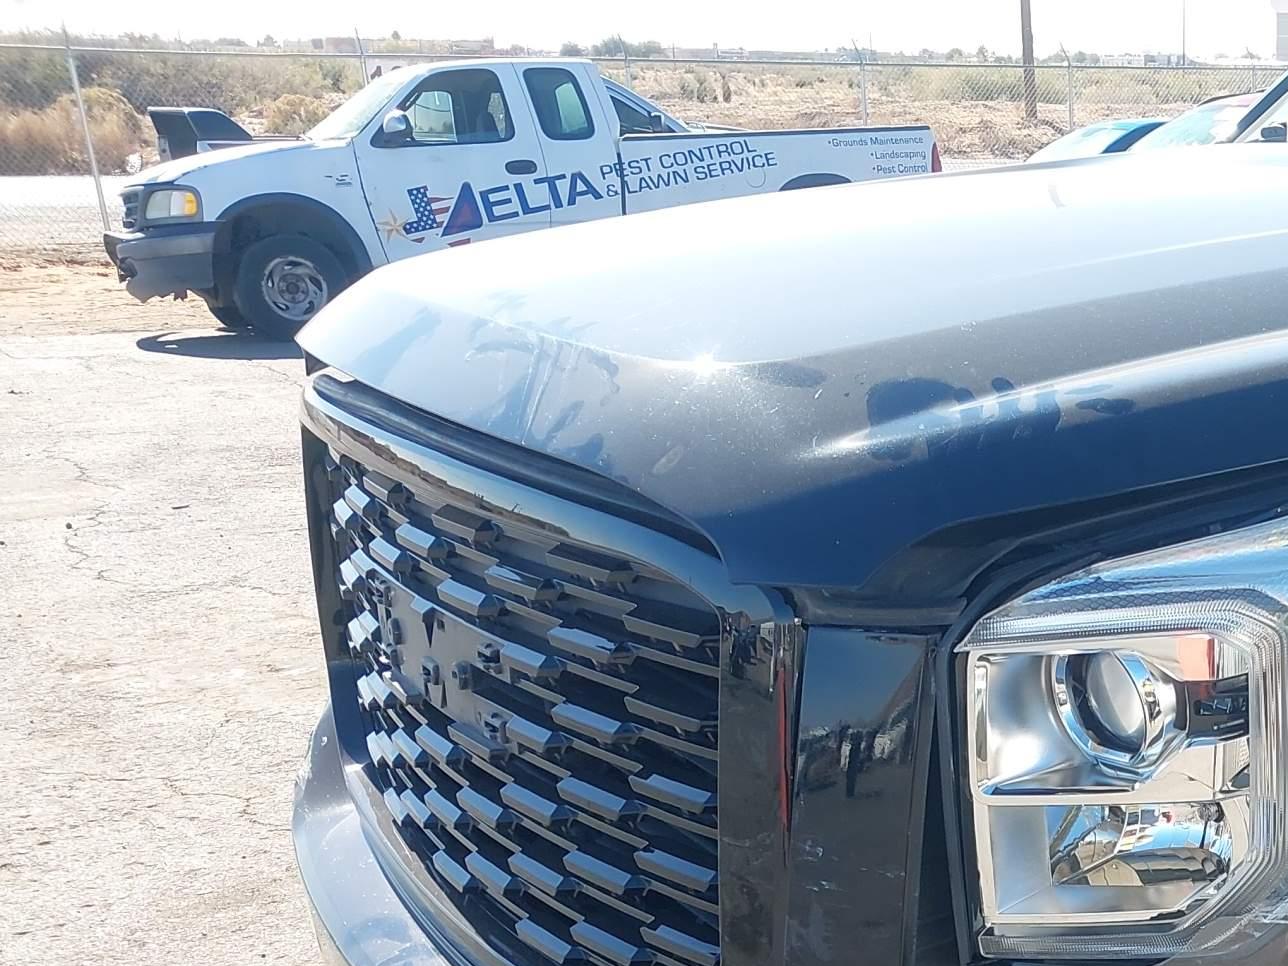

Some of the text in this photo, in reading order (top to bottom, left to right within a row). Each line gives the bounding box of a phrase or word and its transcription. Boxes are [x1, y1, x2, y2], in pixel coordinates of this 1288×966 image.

[869, 136, 924, 146] Maintenance
[599, 139, 758, 181] PEST CONTROL
[876, 162, 928, 174] Pest Control
[606, 151, 778, 198] & LAWN SERVICE
